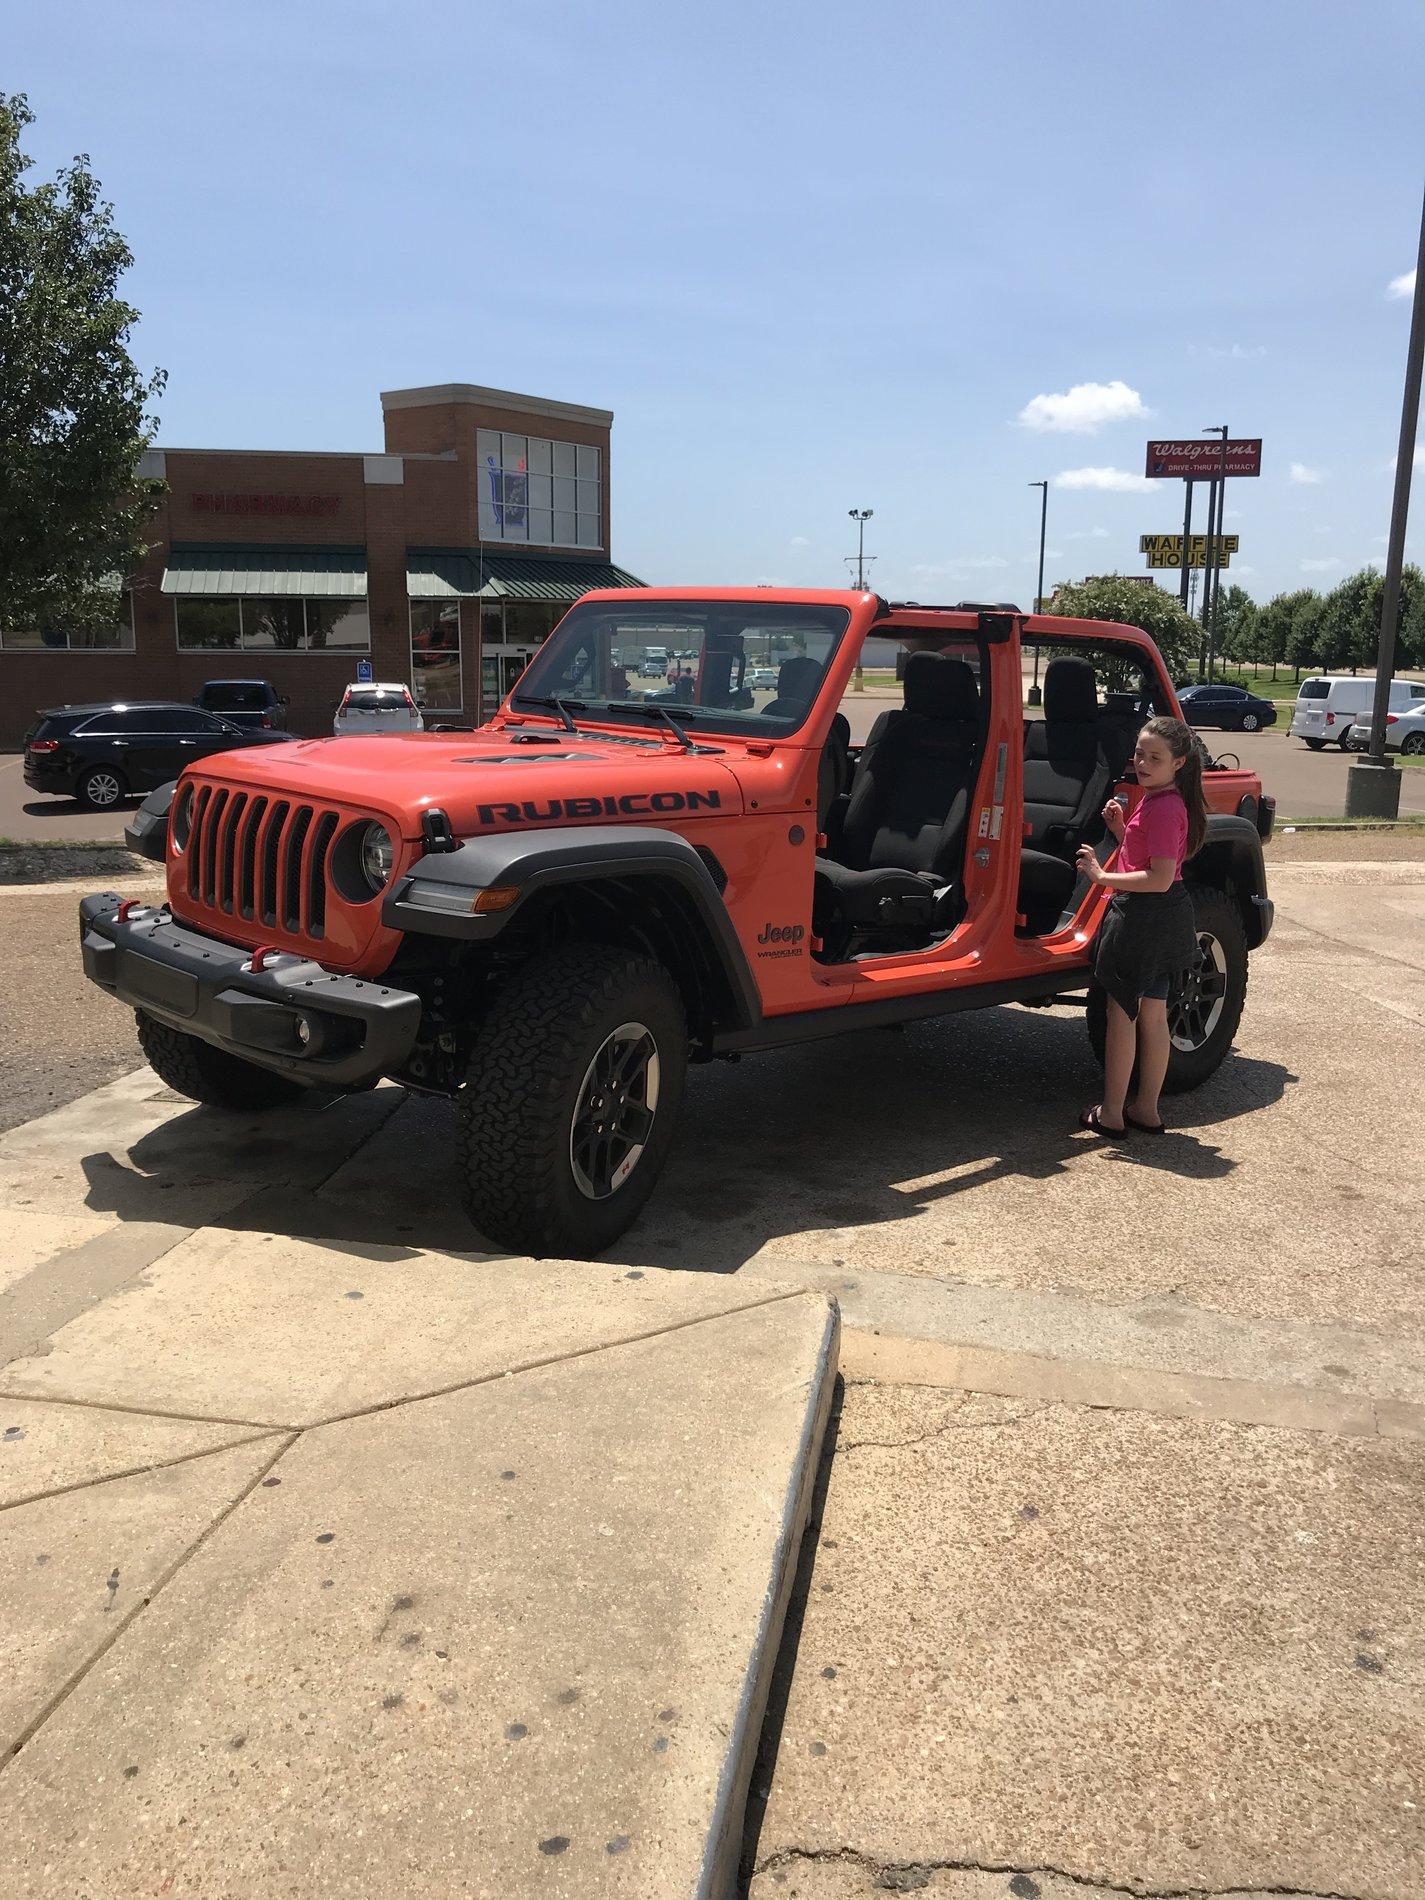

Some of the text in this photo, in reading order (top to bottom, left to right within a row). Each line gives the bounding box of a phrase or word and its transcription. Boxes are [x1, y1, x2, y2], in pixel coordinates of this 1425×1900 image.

[1144, 537, 1236, 550] WAFFE
[475, 790, 721, 825] RUBICON
[757, 922, 804, 944] Jeep
